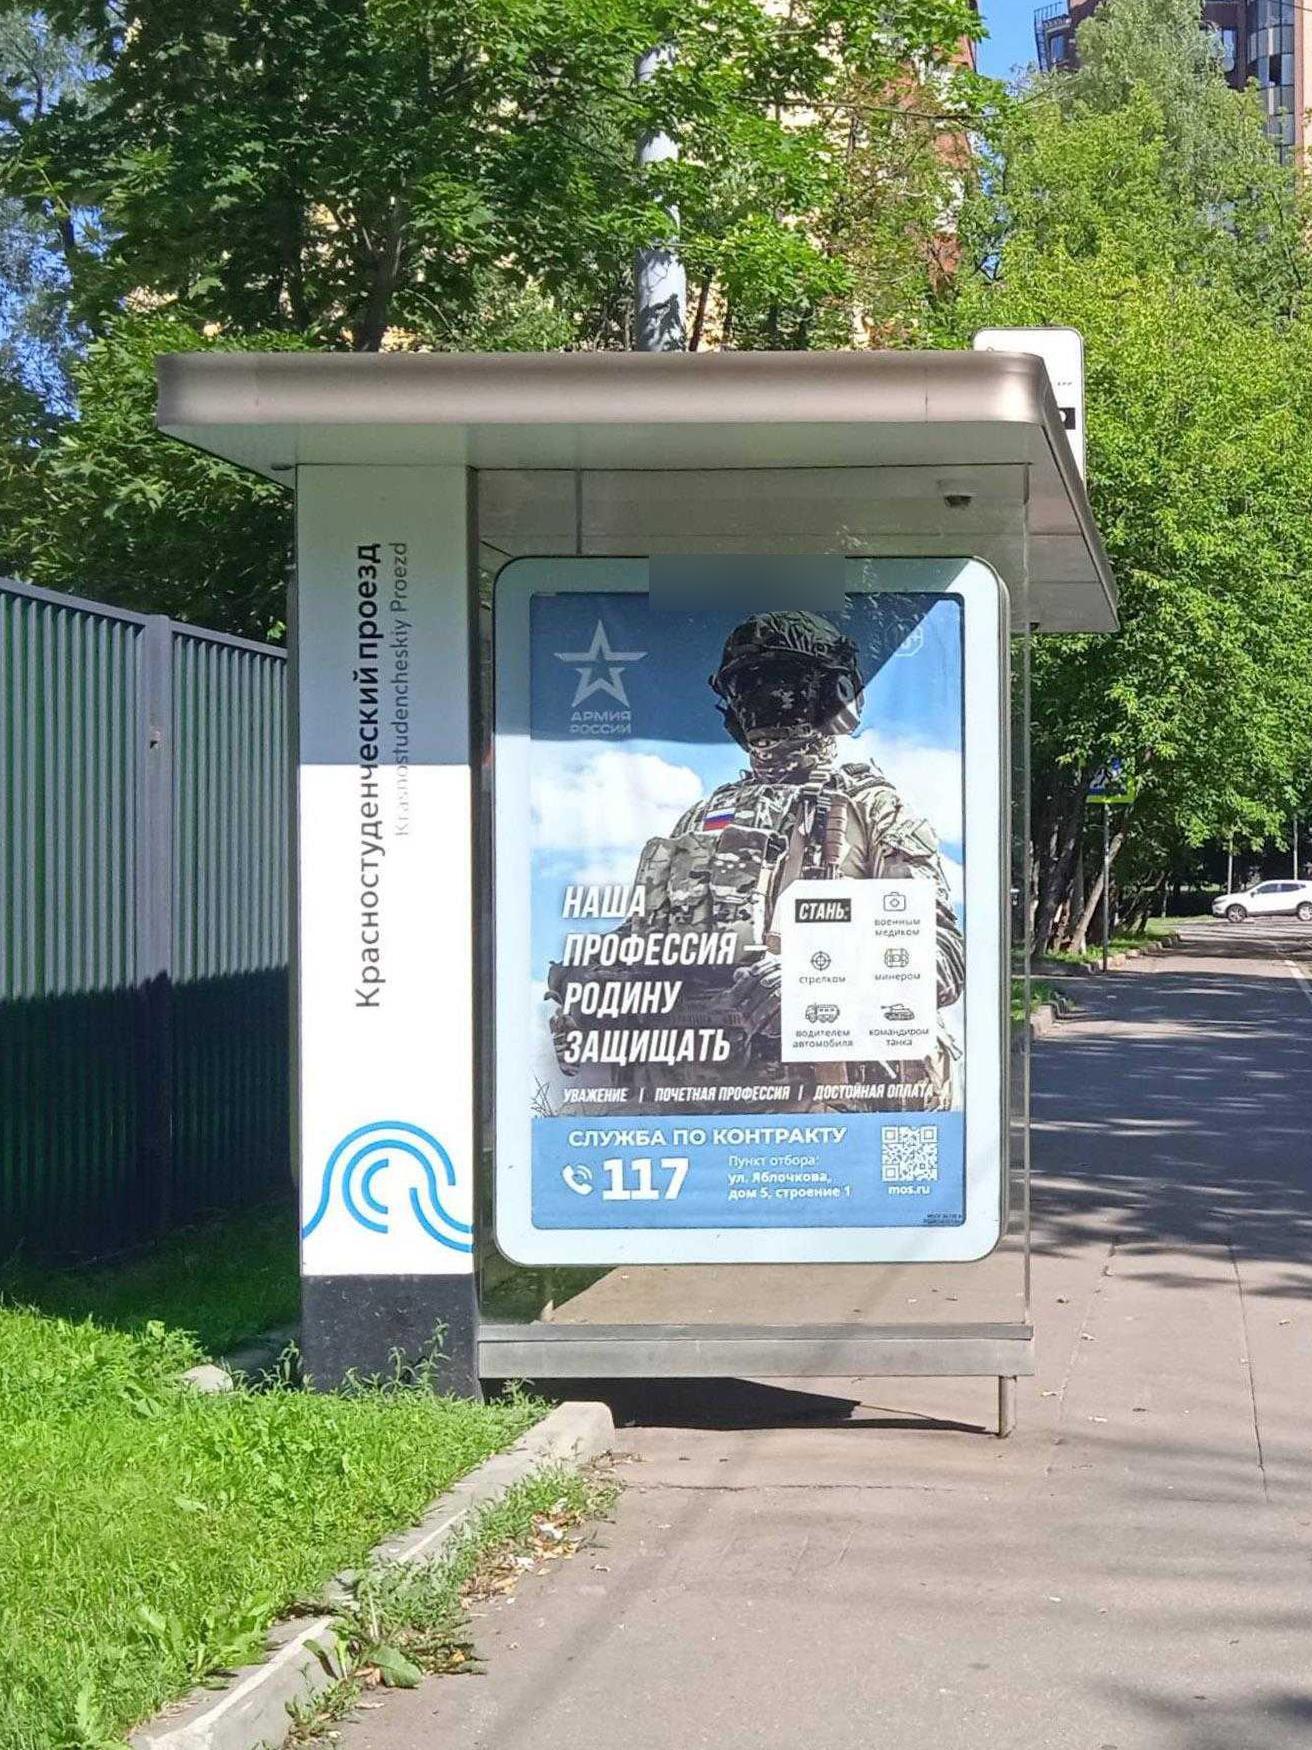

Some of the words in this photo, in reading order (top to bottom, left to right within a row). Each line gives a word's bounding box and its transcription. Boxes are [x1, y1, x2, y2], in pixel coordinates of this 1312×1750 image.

[389, 542, 409, 612] Proezd
[357, 543, 384, 659] проезд
[571, 710, 631, 721] АРМИЯ
[569, 723, 631, 734] РОССИИ
[353, 668, 386, 1008] Красностуденческий
[562, 885, 646, 919] НАША
[799, 902, 850, 920] СТАНЬ:
[562, 932, 738, 967] ПРОФЕССИЯ
[799, 976, 846, 985] стрелком
[875, 973, 921, 982] минером
[563, 981, 683, 1018] РОДИНУ
[796, 1029, 851, 1038] водителем
[869, 1028, 929, 1037] командиром
[563, 1029, 732, 1067] ЗАЩИЩАТЬ
[793, 1038, 854, 1048] автомобиля
[886, 1038, 913, 1047] танка
[563, 1088, 629, 1102] УВАЖЕНИЕ
[654, 1087, 717, 1102] ПОЧЕТНАЯ
[718, 1085, 791, 1101] ПРОФЕССИЯ
[813, 1083, 885, 1101] ДОСТОЙНАЯ
[887, 1083, 934, 1099] ОПЛАТА
[568, 1129, 667, 1147] СЛУЖБА
[673, 1128, 707, 1146] ПО
[713, 1126, 848, 1146] КОНТРАКТУ
[728, 1155, 766, 1169] Пункт
[602, 1157, 689, 1201] 117
[728, 1173, 749, 1185] ул.
[752, 1171, 832, 1184] Яблочкова,
[728, 1188, 757, 1200] дом
[760, 1187, 772, 1199] 5,
[775, 1186, 841, 1200] строение
[844, 1185, 851, 1197] 1
[888, 1185, 931, 1195] mos.ru
